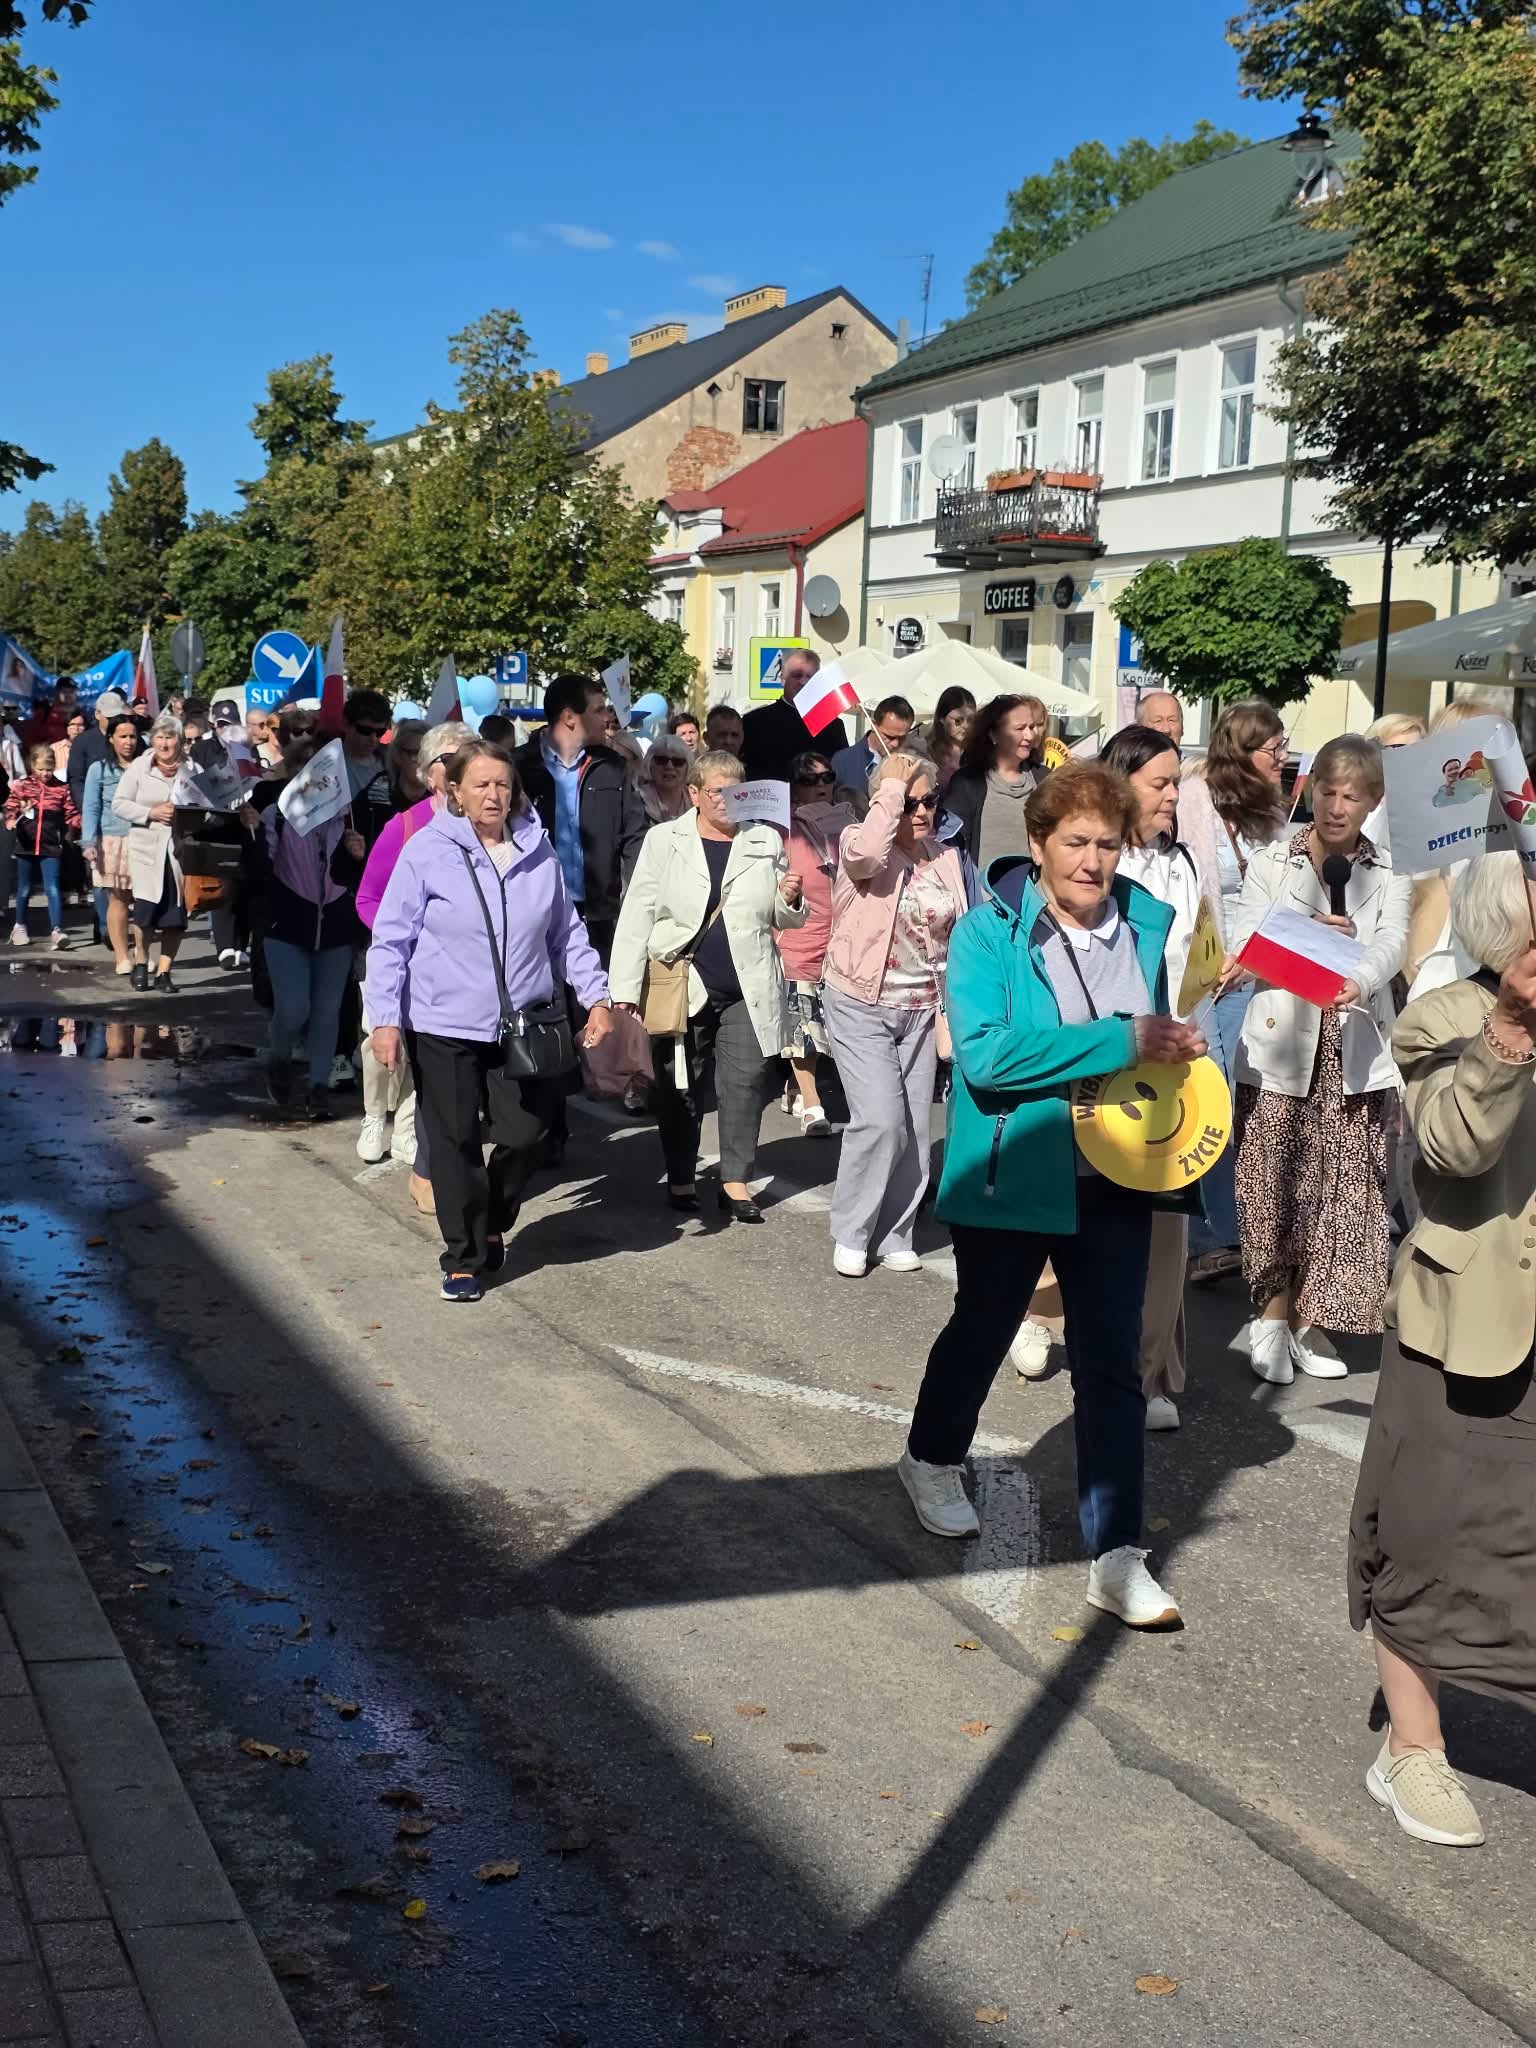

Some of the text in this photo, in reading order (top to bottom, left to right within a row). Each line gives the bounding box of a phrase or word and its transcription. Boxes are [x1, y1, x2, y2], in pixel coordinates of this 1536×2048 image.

[985, 586, 1030, 610] COFFEE
[503, 655, 521, 681] P
[1454, 654, 1490, 671] Kozel
[1427, 826, 1472, 852] DZIECI
[1178, 1125, 1225, 1177] ŻYCIE
